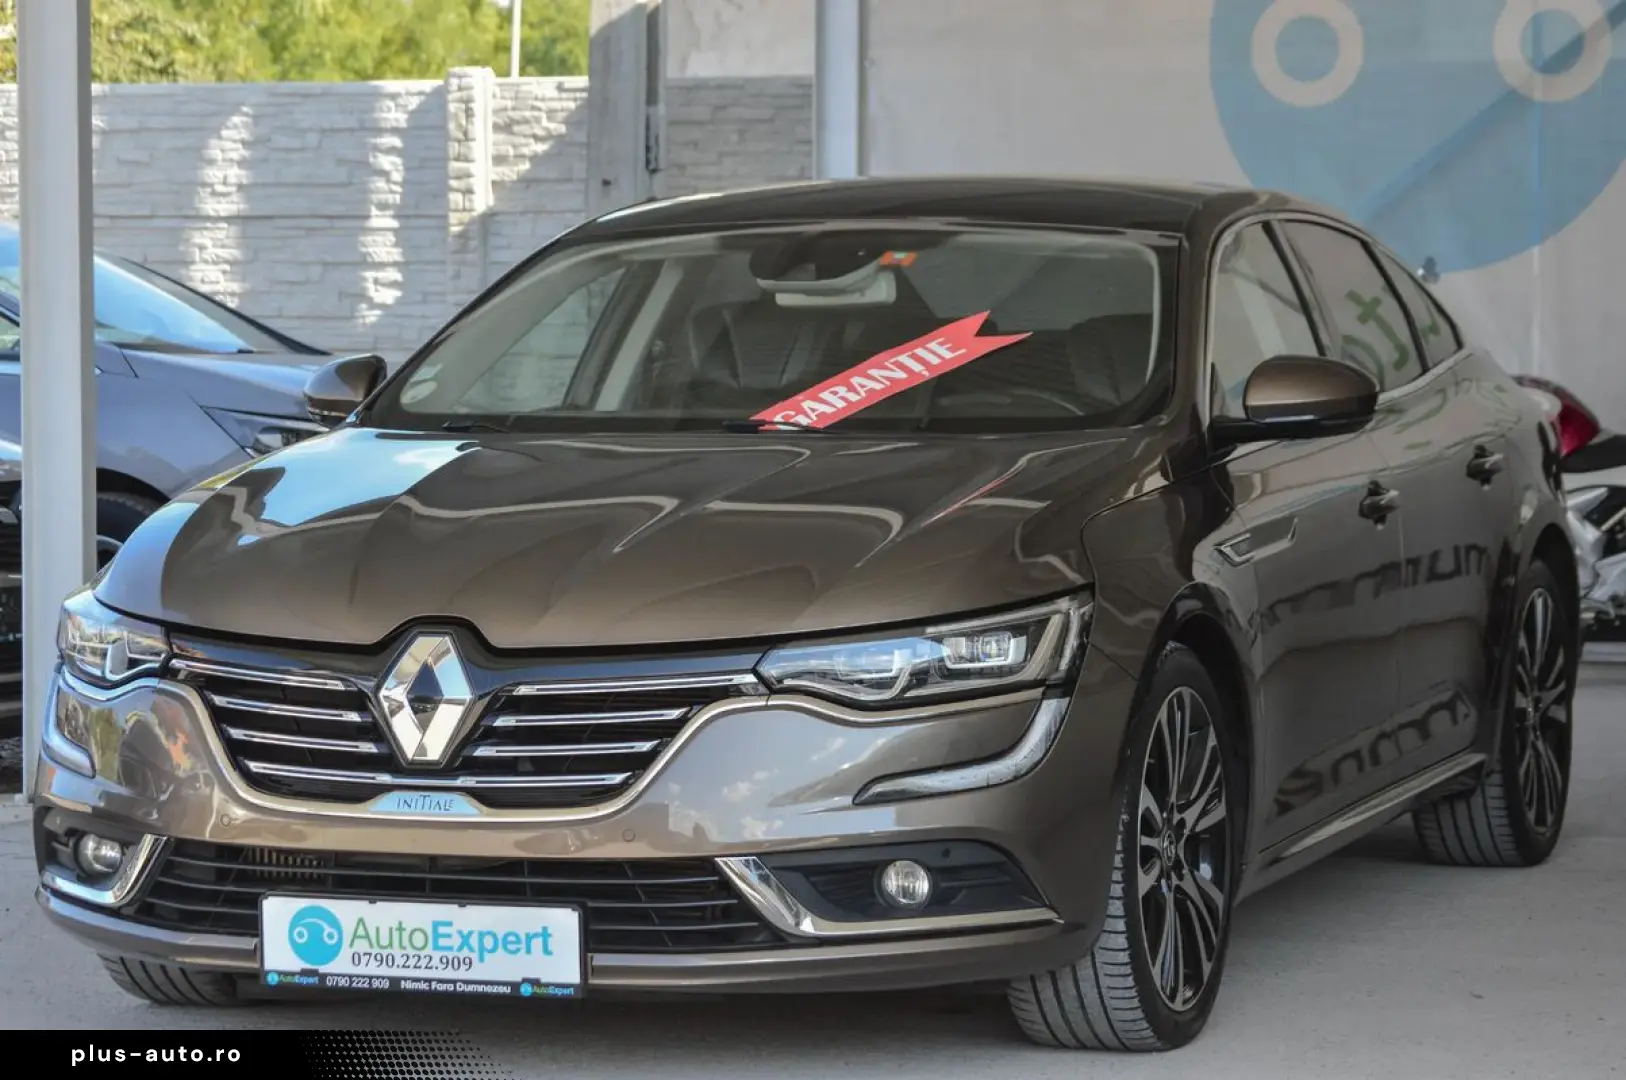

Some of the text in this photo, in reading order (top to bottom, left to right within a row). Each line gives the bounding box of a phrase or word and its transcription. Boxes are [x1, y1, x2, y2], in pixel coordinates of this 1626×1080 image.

[396, 794, 454, 811] INITIALE
[349, 916, 554, 963] AutoExpert
[352, 952, 473, 971] 0790.222.909
[279, 974, 574, 996] AutoExpert 0790 222 909 Nimic Fara Dumnezeu AutoExpert
